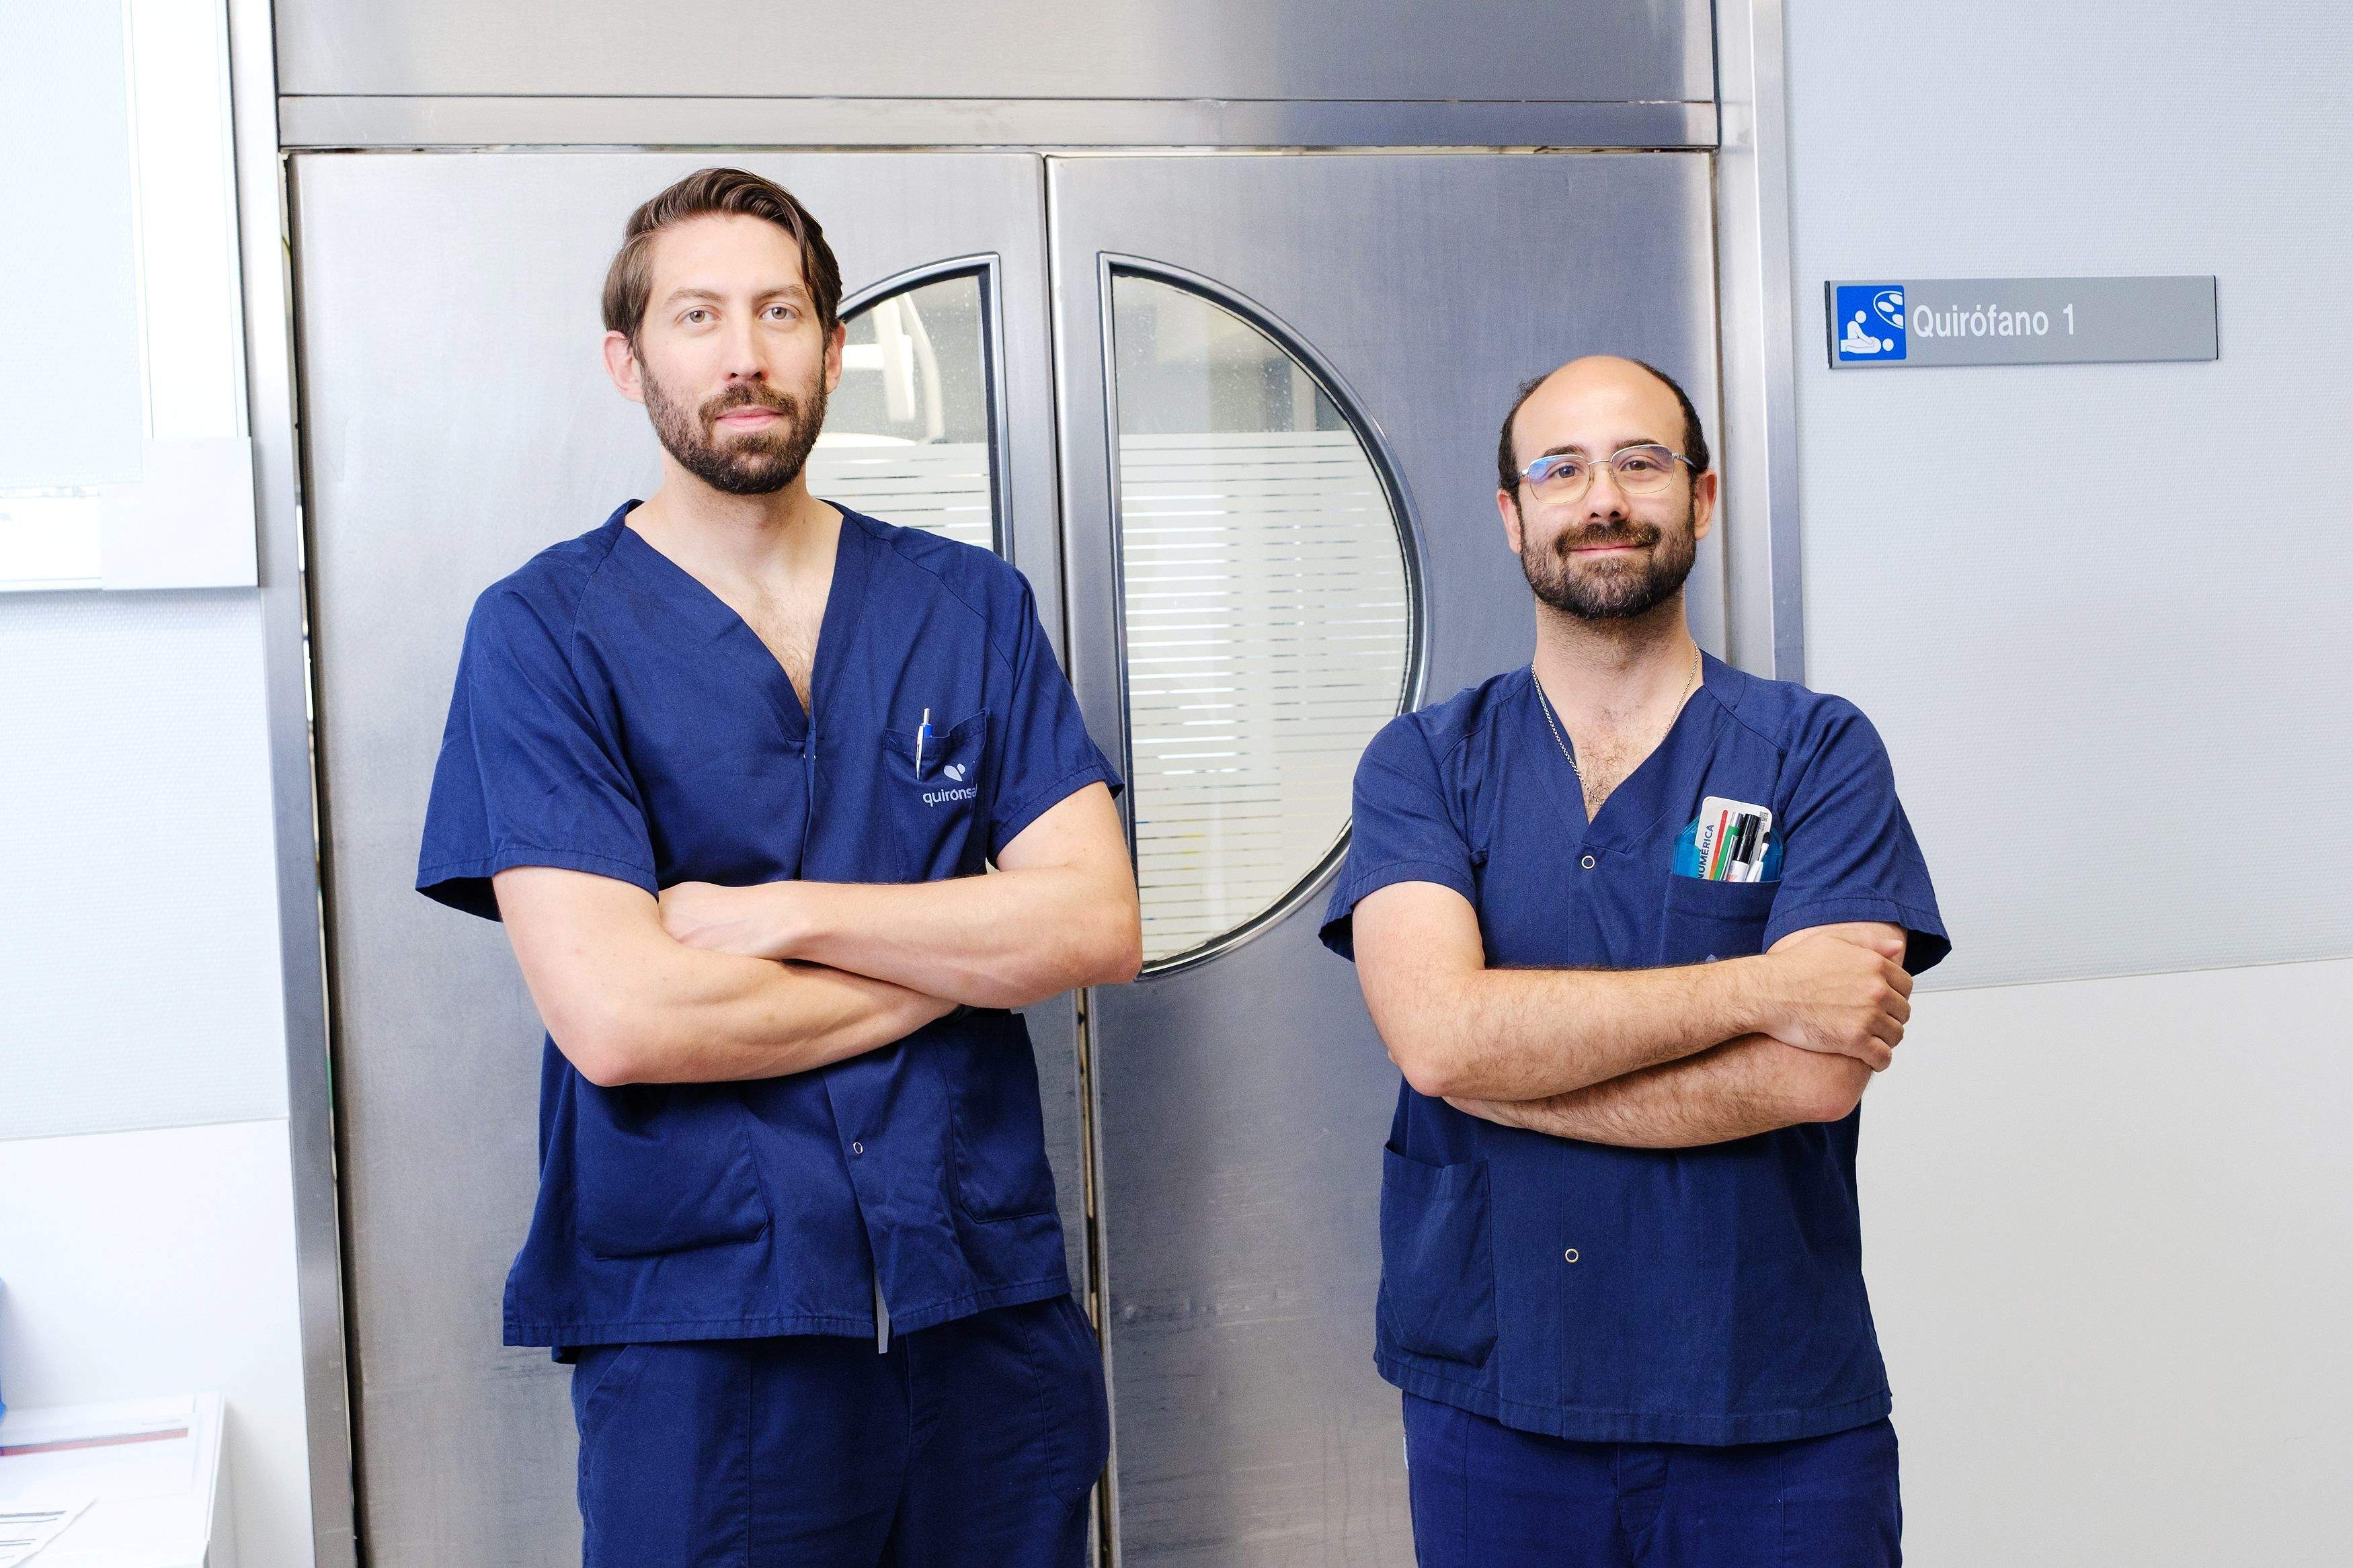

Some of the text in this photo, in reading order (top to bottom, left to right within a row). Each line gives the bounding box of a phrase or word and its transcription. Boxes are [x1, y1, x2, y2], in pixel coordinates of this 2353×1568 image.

[1913, 303, 2074, 337] Quirófano 1
[922, 784, 978, 807] quirónsa
